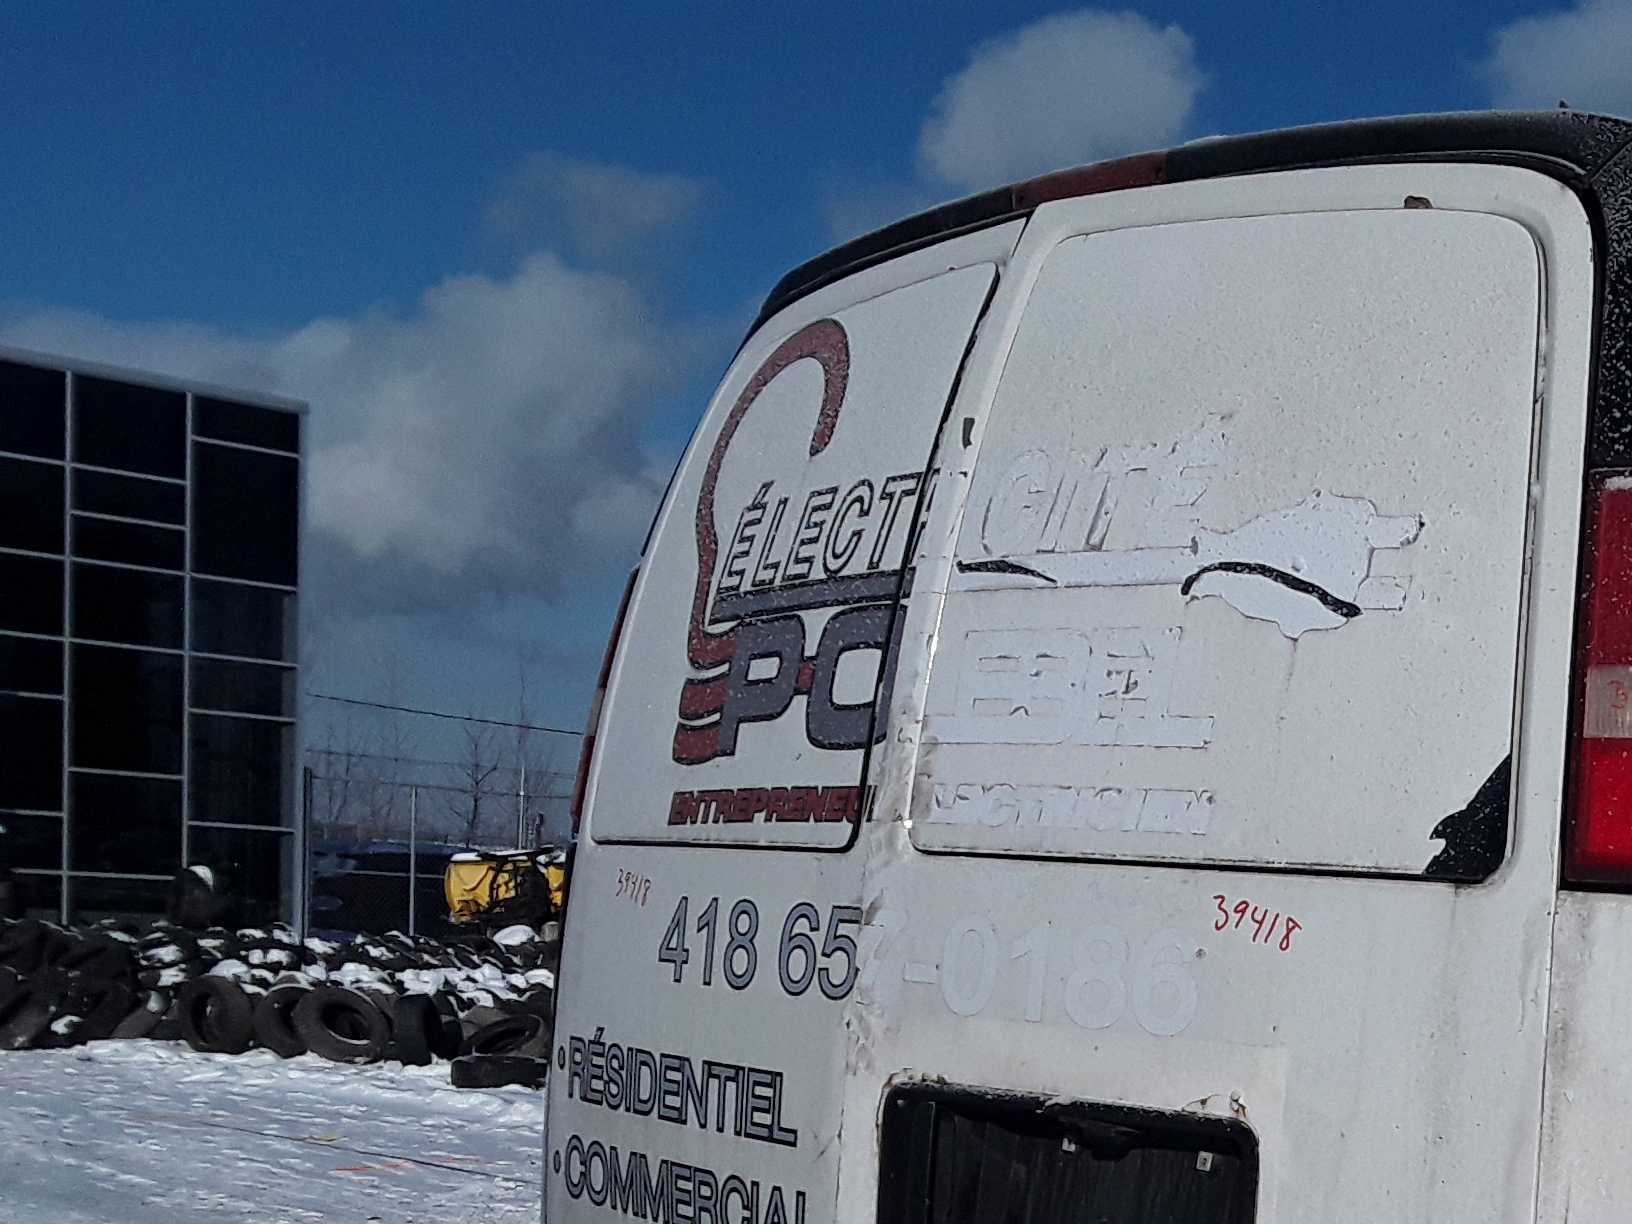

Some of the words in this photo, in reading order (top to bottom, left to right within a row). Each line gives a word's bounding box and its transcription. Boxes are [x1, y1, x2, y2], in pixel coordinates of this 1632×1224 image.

[657, 896, 760, 990] 418
[1213, 894, 1303, 952] 39418
[567, 1027, 798, 1148] RÉSIDENTIEL
